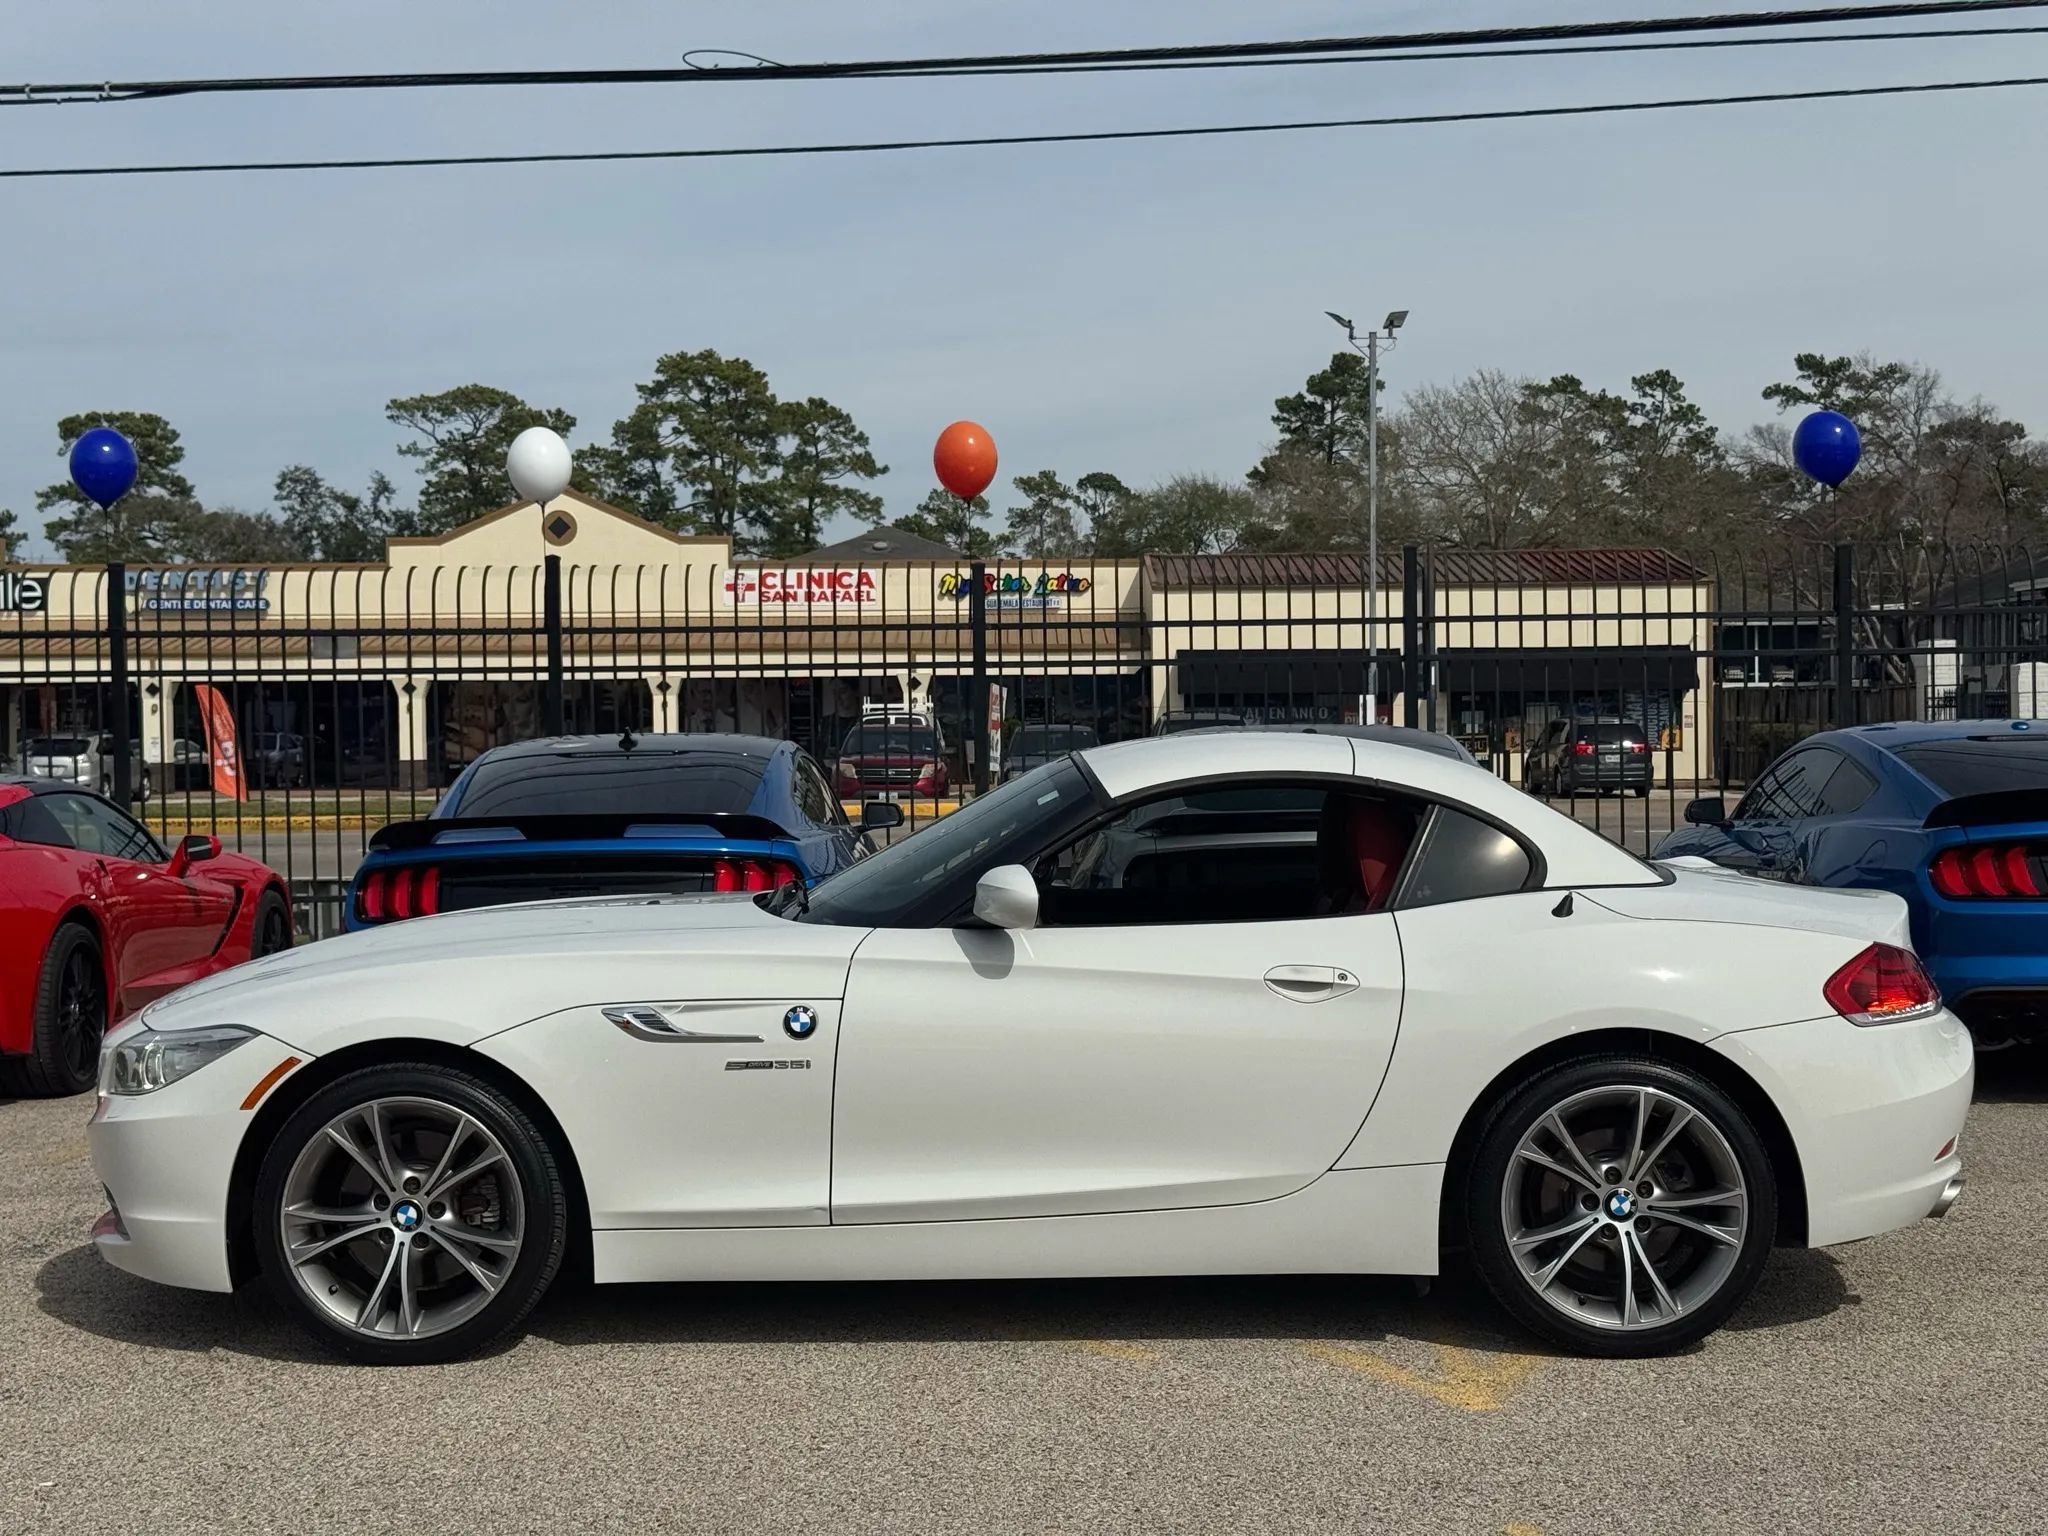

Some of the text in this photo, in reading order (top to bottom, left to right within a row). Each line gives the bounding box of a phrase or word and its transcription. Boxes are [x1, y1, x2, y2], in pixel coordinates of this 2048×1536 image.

[760, 571, 875, 590] CLINICA
[760, 591, 876, 603] SAN RAFAEL
[236, 601, 266, 609] CARE
[986, 598, 1018, 608] GUAEMALA
[1020, 598, 1053, 608] ESTAURNT
